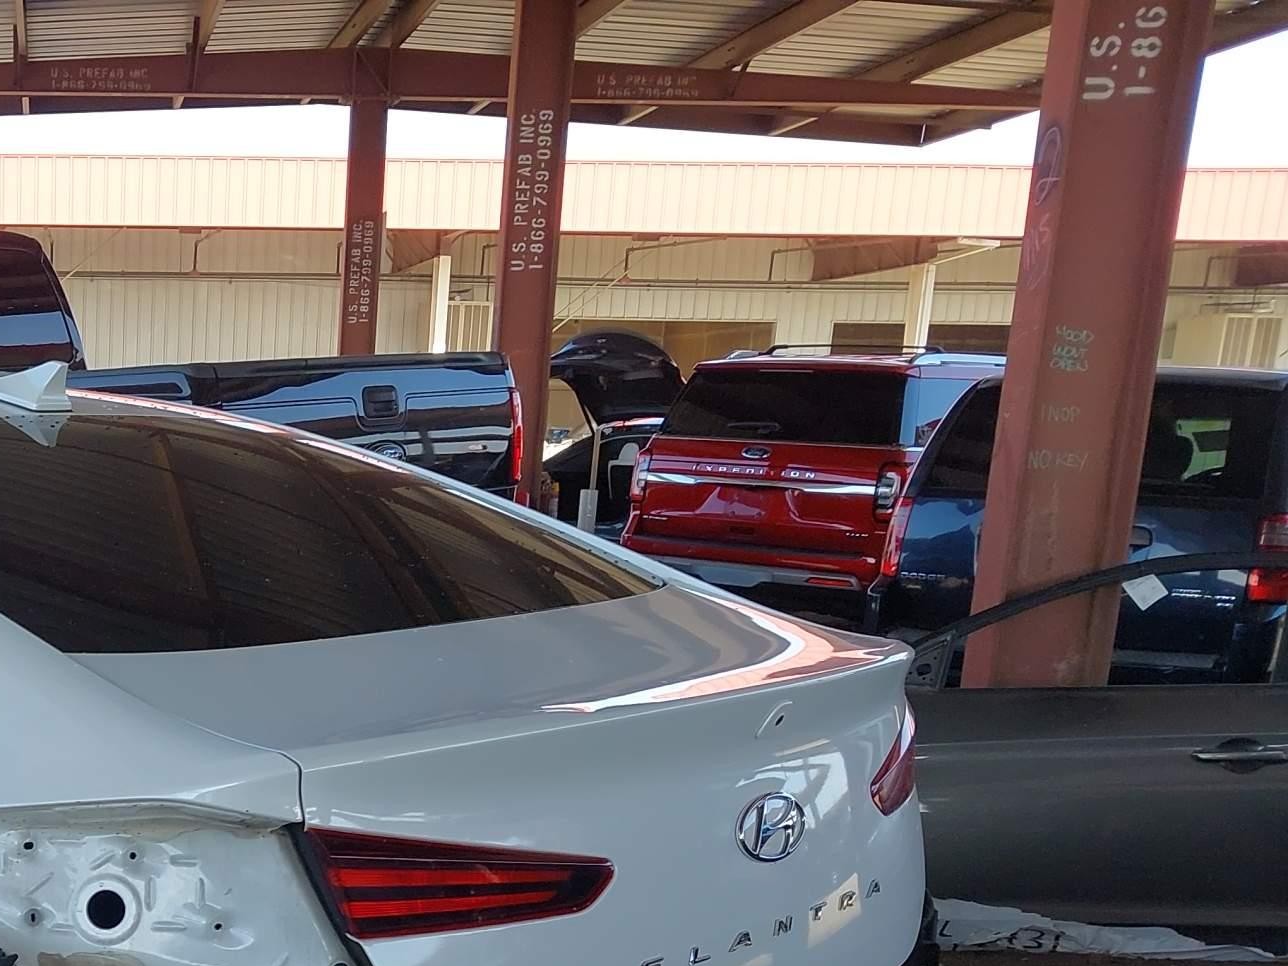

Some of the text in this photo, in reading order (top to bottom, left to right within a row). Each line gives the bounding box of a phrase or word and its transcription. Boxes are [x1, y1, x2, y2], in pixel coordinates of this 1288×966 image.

[79, 67, 124, 80] PREFAB
[626, 75, 672, 87] PREAB
[1082, 22, 1125, 100] U.S.
[514, 154, 533, 226] PREFAB
[529, 109, 554, 270] 1-866-799-0969
[349, 248, 361, 295] PREFAB
[359, 220, 374, 322] 1-866-799-0969
